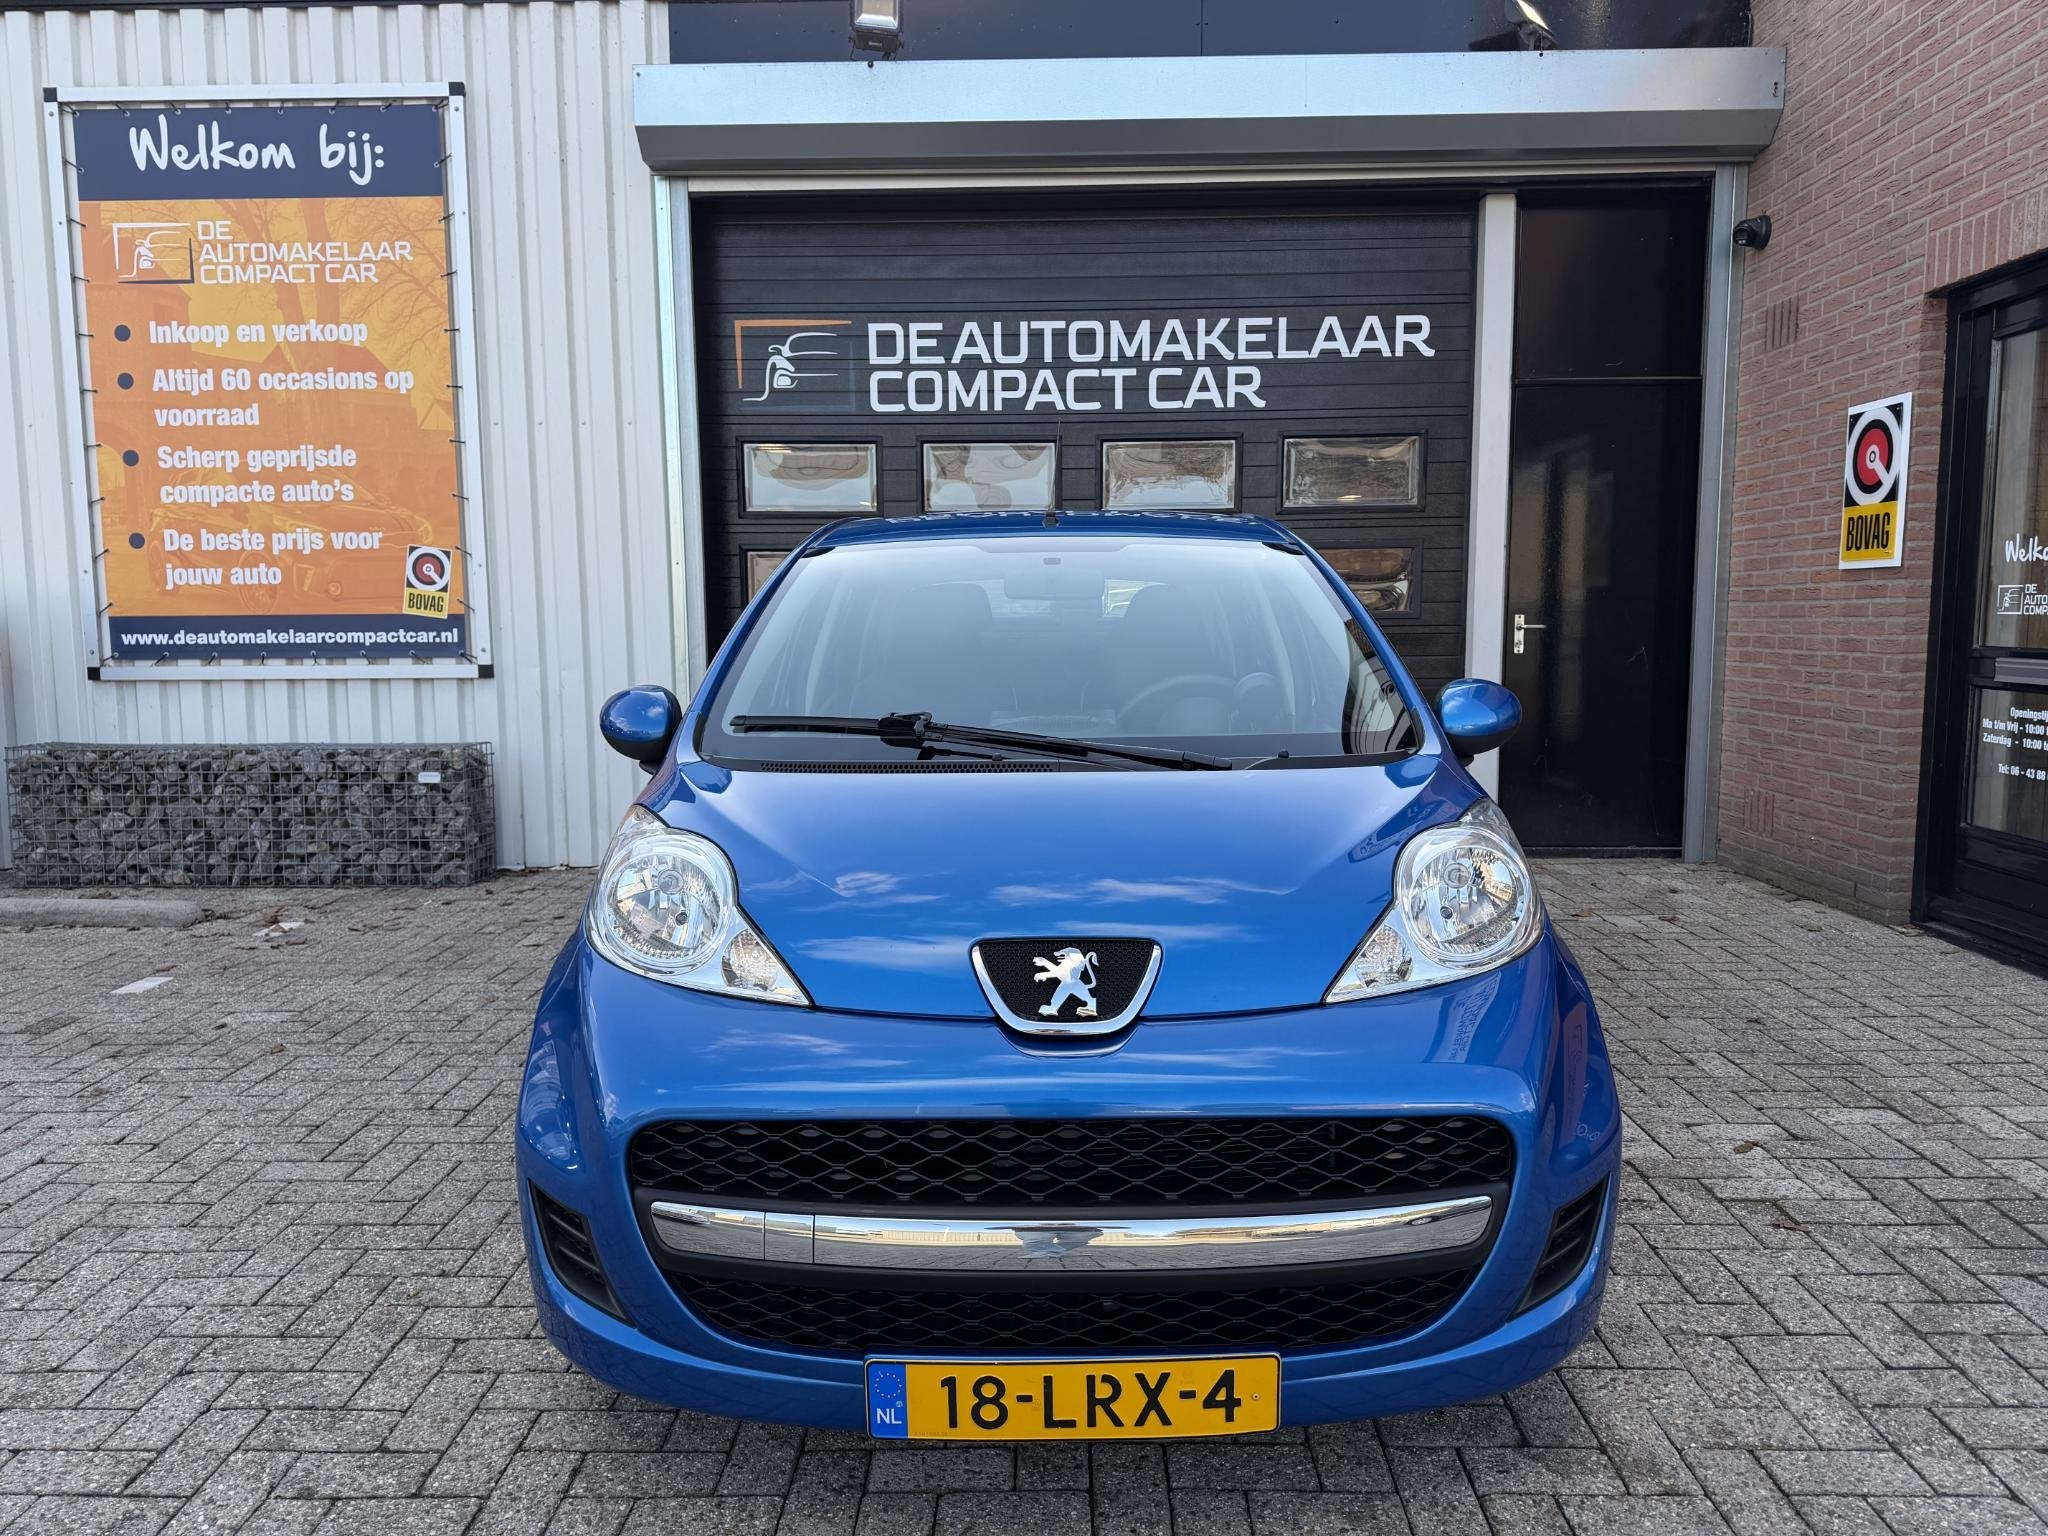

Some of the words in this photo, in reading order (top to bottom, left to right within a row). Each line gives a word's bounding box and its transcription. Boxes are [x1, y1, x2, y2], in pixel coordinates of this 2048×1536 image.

[129, 113, 296, 171] Welkom
[319, 123, 385, 186] bij:
[197, 219, 234, 241] DE
[199, 240, 414, 263] AUTOMAKELAAR
[200, 263, 320, 285] COMPACT
[325, 262, 380, 284] CAR
[149, 320, 229, 349] Inkoop
[236, 323, 264, 343] en
[272, 318, 368, 348] verkoop
[867, 321, 947, 364] DE
[954, 314, 1436, 364] AUTOMAKELAAR
[152, 367, 214, 396] Altijd
[220, 366, 251, 392] 60
[258, 366, 378, 391] occasions
[384, 370, 414, 393] op
[869, 366, 1136, 413] COMPACT
[1147, 365, 1267, 410] CAR
[154, 403, 260, 427] voorraad
[157, 444, 240, 473] Scherp
[247, 443, 357, 472] geprijsde
[160, 479, 275, 507] compacte
[282, 478, 355, 504] auto's
[163, 529, 194, 552] De
[201, 527, 265, 551] beste
[272, 527, 325, 554] prijs
[331, 531, 383, 550] voor
[1846, 512, 1890, 551] BOVAG
[165, 563, 224, 590] jouw
[230, 563, 282, 586] auto
[2024, 584, 2037, 593] DE
[407, 592, 445, 613] BOVAG
[2023, 605, 2048, 615] COMP
[121, 627, 459, 647] www.deautomakelaarcompactcar.nl
[1982, 732, 2012, 747] Zaterdag
[2022, 738, 2042, 750] 10:00
[940, 1368, 1242, 1430] 18-LRX-4
[877, 1407, 902, 1425] NL
